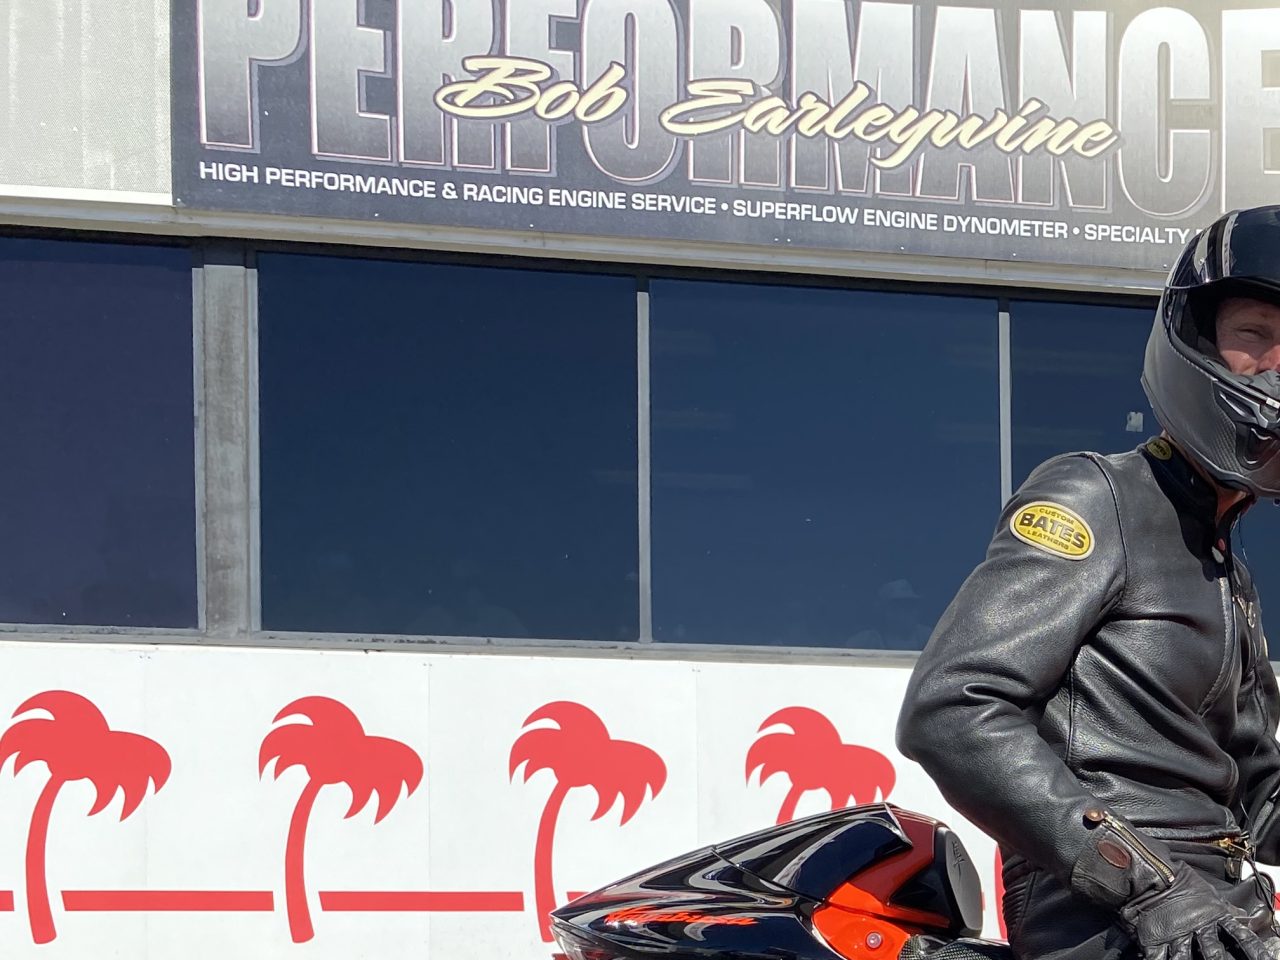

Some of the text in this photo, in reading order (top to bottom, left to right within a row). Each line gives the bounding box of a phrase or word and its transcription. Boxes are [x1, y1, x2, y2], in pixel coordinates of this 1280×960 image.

[435, 56, 1119, 170] Bob Earleywine
[199, 161, 1190, 245] HIGH PERFORMANCE & RACING ENGINE SERVICE SUPERFLOW ENGINE DYNOMETER SPECIALTY
[1019, 512, 1086, 549] BATES
[1039, 508, 1075, 525] CUSTOM
[1027, 529, 1069, 550] LEATHERS
